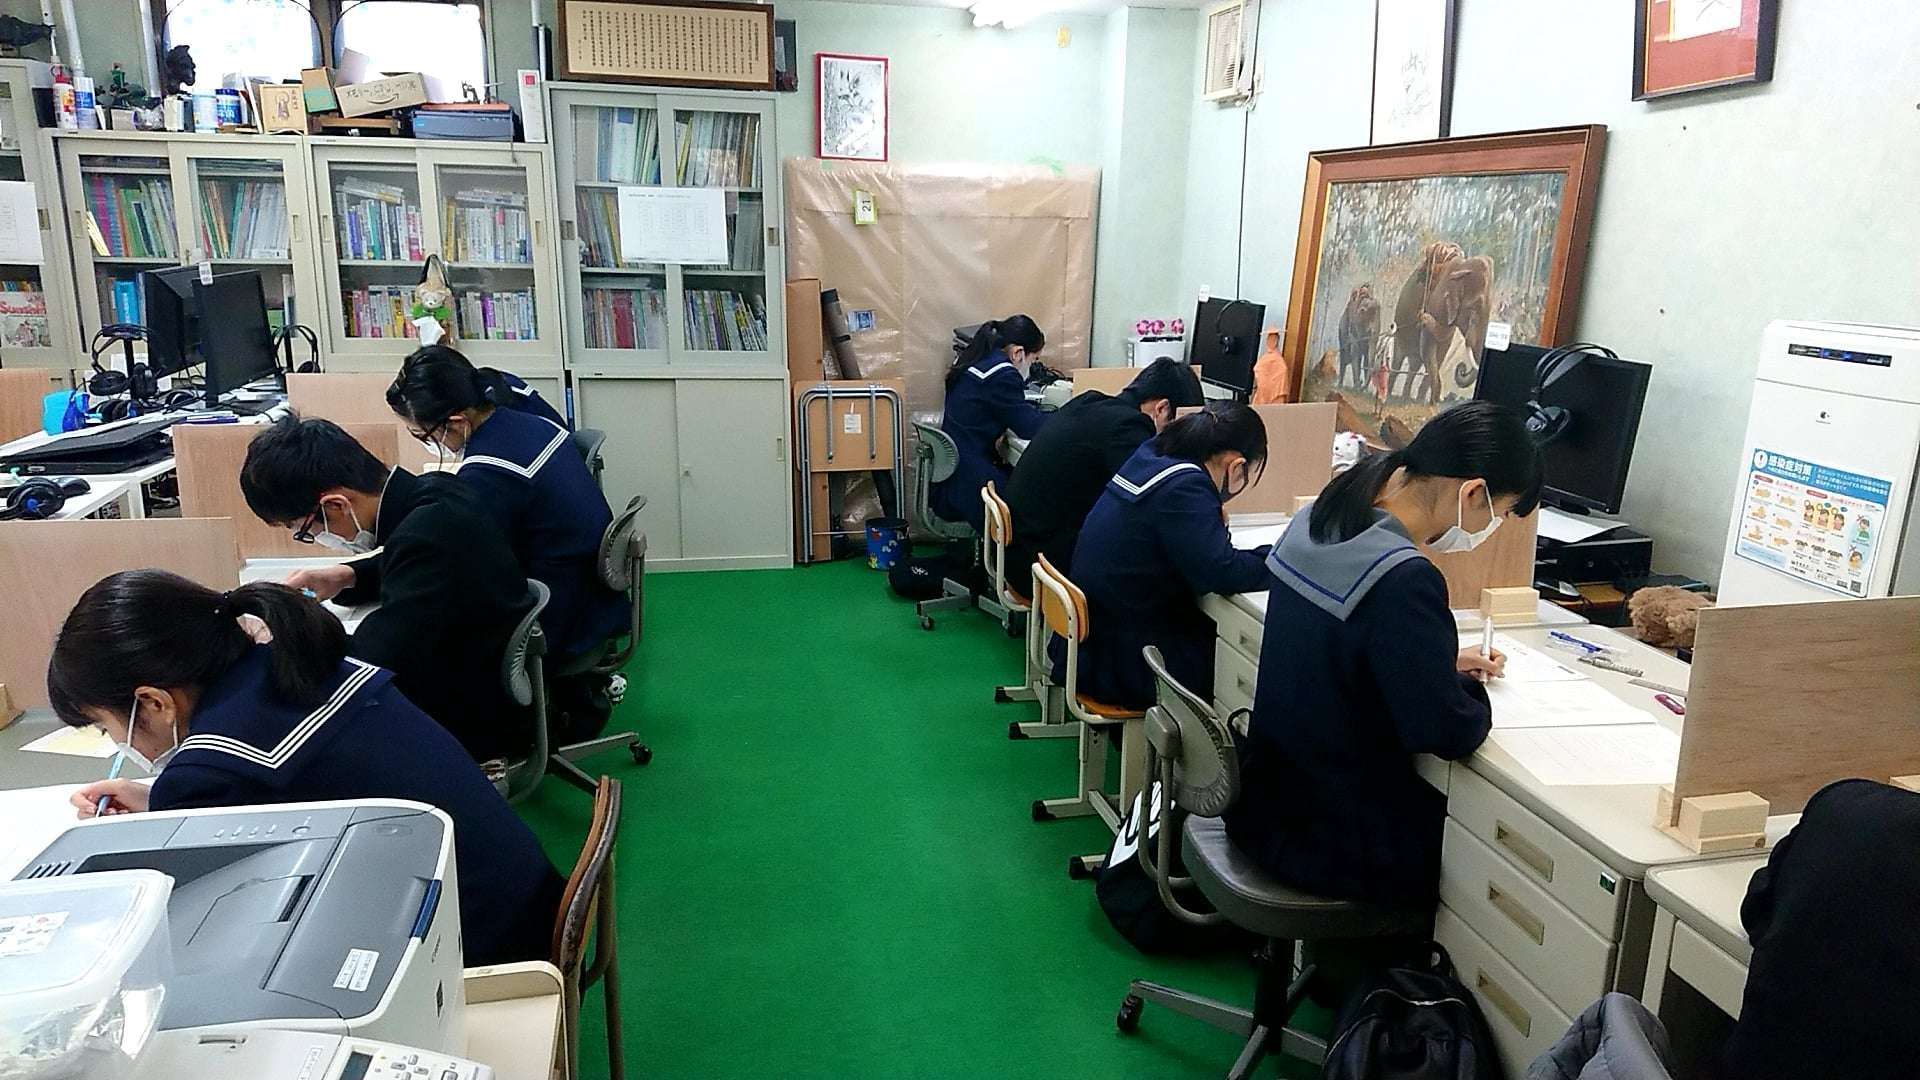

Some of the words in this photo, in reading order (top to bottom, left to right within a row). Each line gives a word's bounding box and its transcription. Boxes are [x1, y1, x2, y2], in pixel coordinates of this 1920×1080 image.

[862, 200, 871, 212] 21
[1768, 456, 1812, 476] 感染症対策
